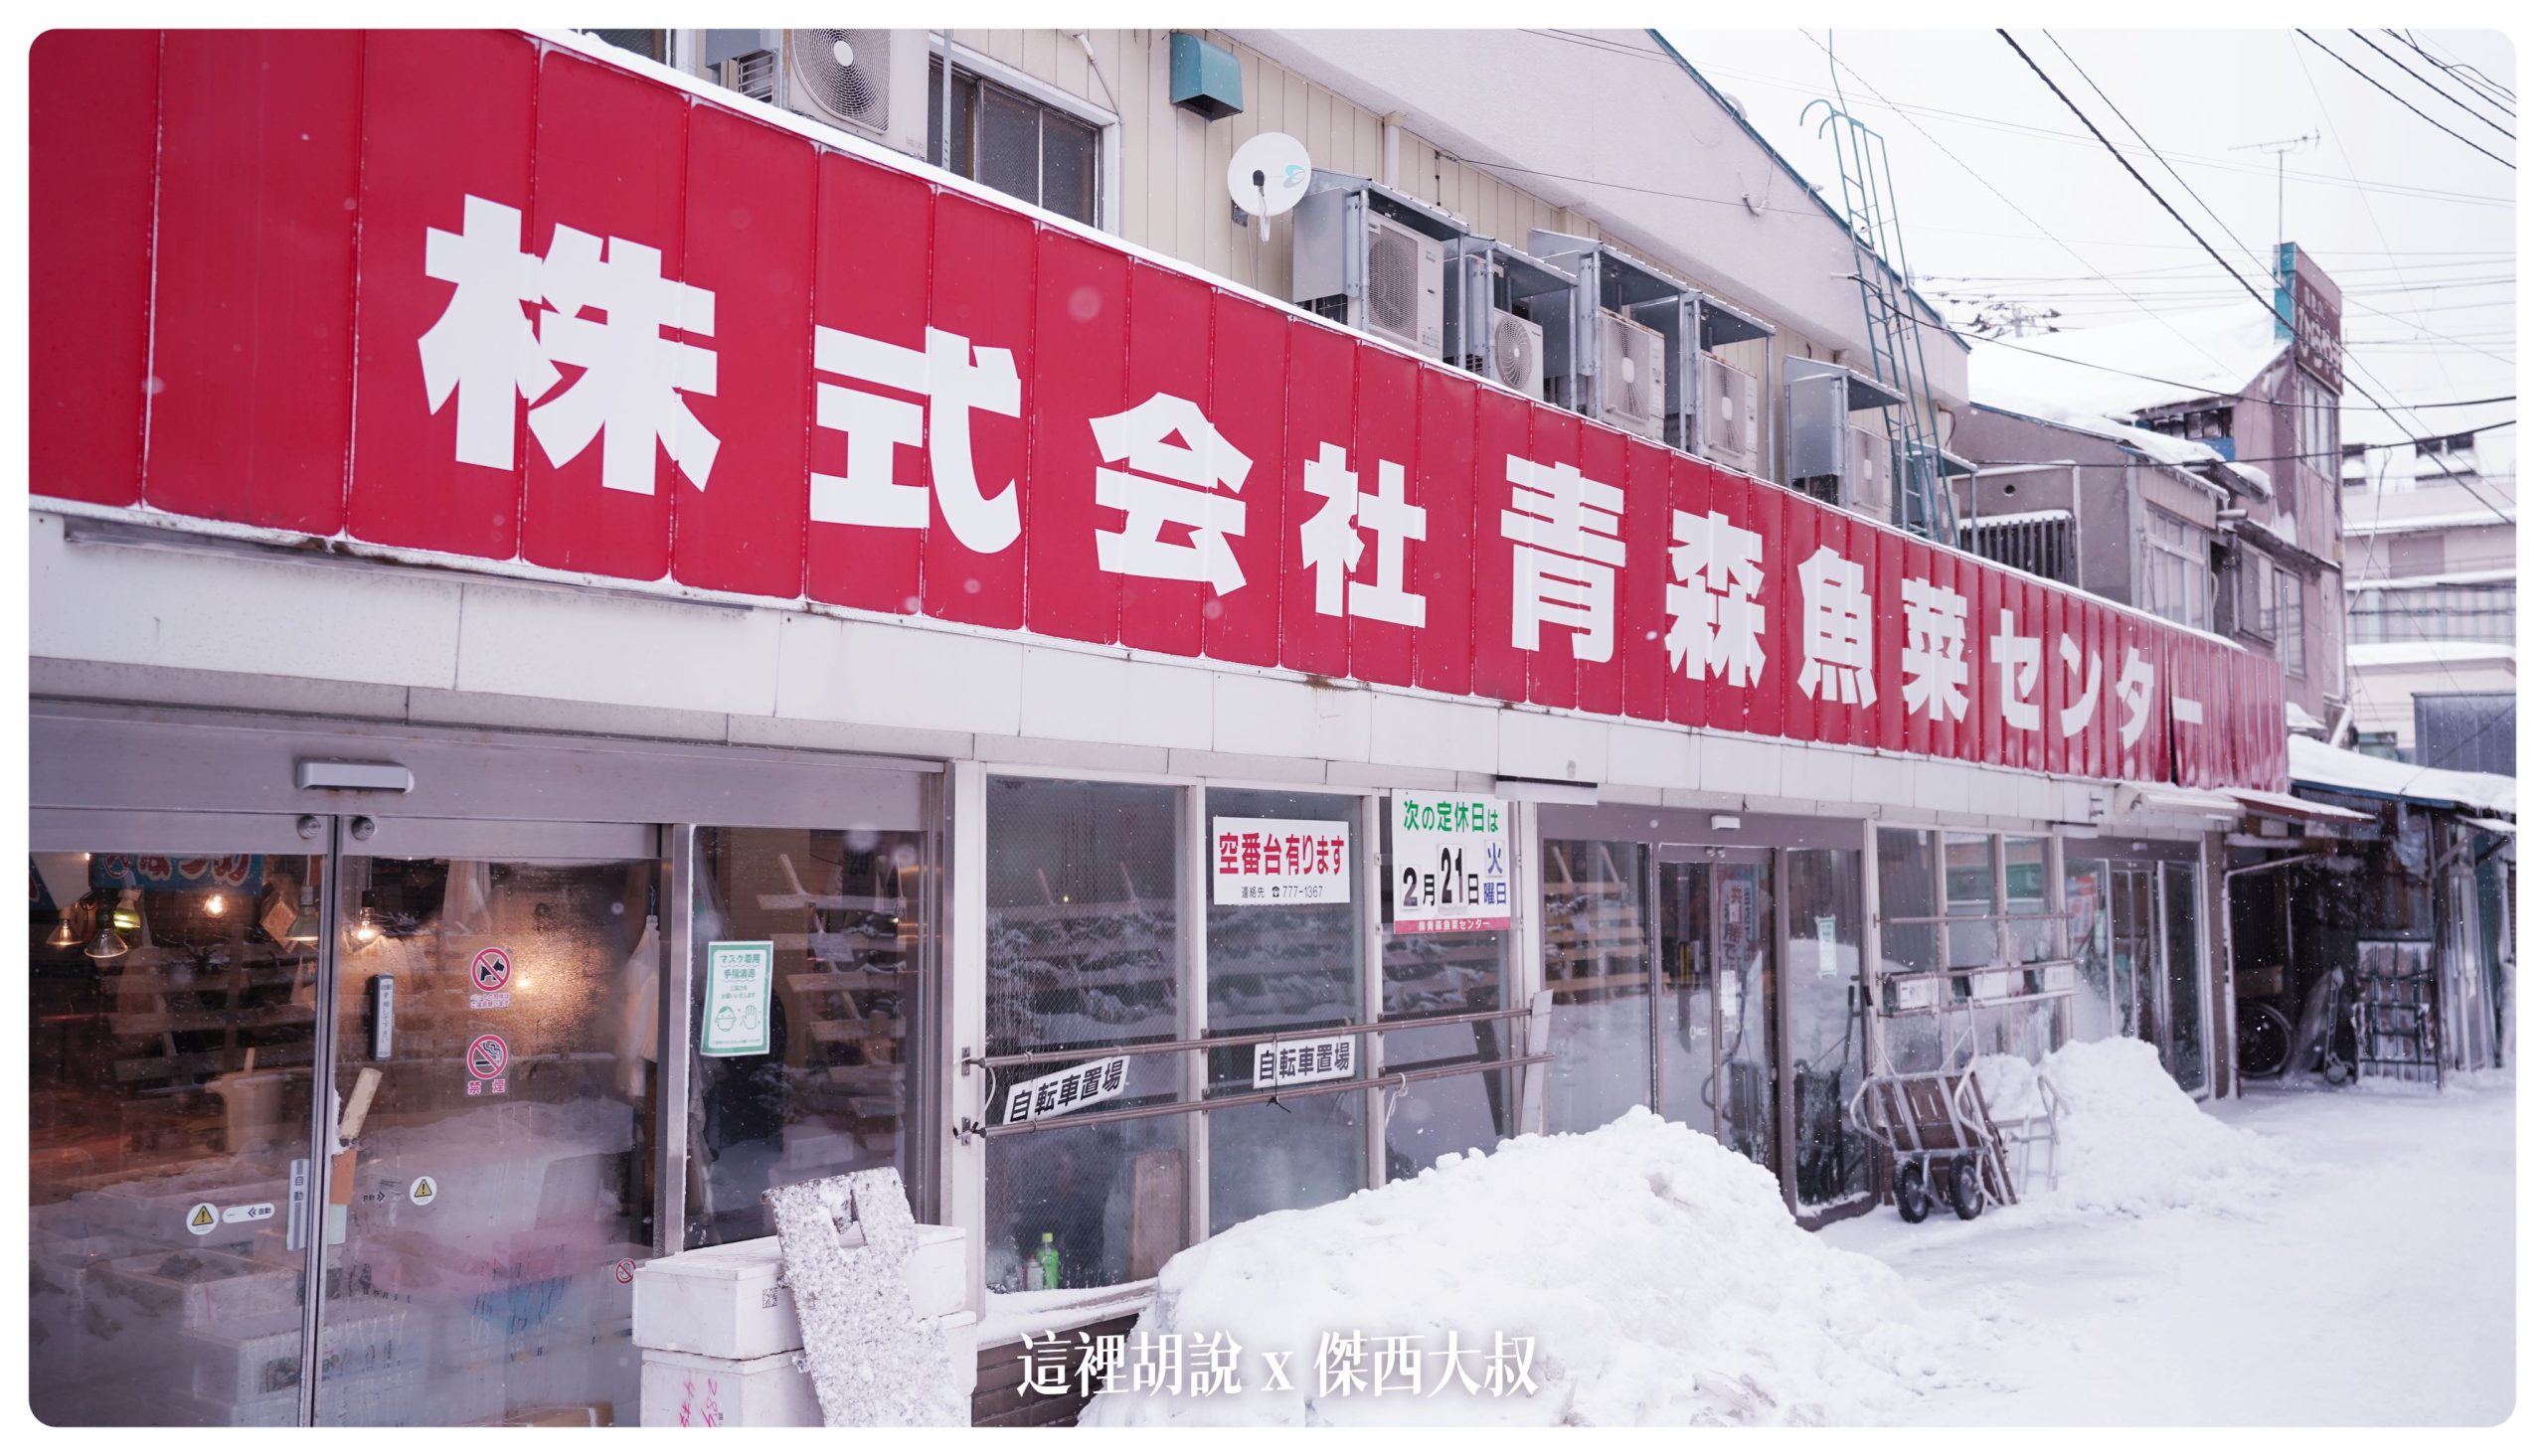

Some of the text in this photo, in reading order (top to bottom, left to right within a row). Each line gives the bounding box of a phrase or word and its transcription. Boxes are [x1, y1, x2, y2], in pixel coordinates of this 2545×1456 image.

[418, 194, 2203, 748] 株式会社 青森魚菜センター
[1403, 799, 1498, 833] 次の定休日は
[1219, 832, 1345, 876] 空番台有ります
[1487, 842, 1503, 875] 火
[1241, 886, 1323, 898] 連絡先 777-1367
[1403, 847, 1479, 907] 2月21日
[1483, 883, 1507, 905] 曜日
[721, 953, 761, 964] マスク着用
[724, 968, 756, 979] 手指消毒
[1259, 1042, 1351, 1082] 自転車置場
[467, 1079, 506, 1094] 禁煙
[1009, 1059, 1124, 1124] 自転車置場
[258, 1207, 271, 1215] 自動
